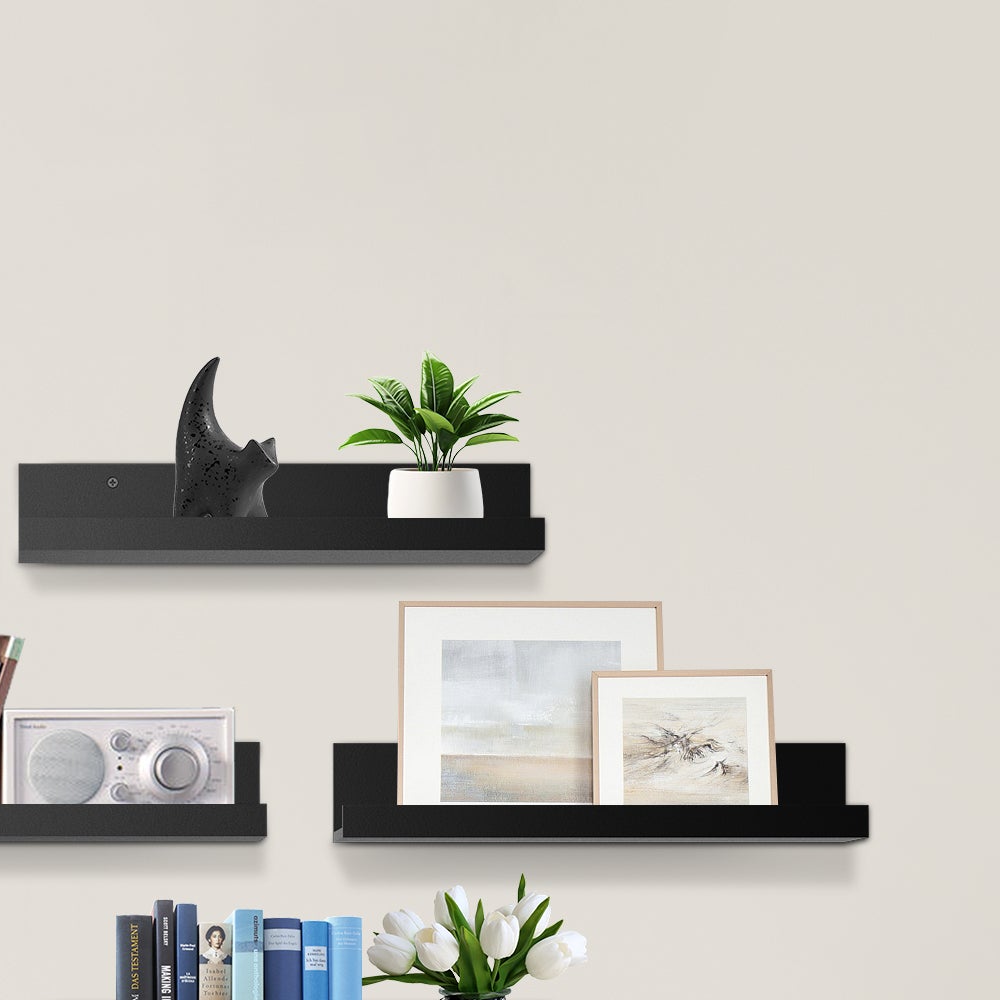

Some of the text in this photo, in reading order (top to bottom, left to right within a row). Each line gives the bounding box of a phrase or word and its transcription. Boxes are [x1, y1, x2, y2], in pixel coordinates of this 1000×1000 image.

[130, 924, 140, 990] DAS TESTAMENT
[161, 965, 171, 994] MAKING
